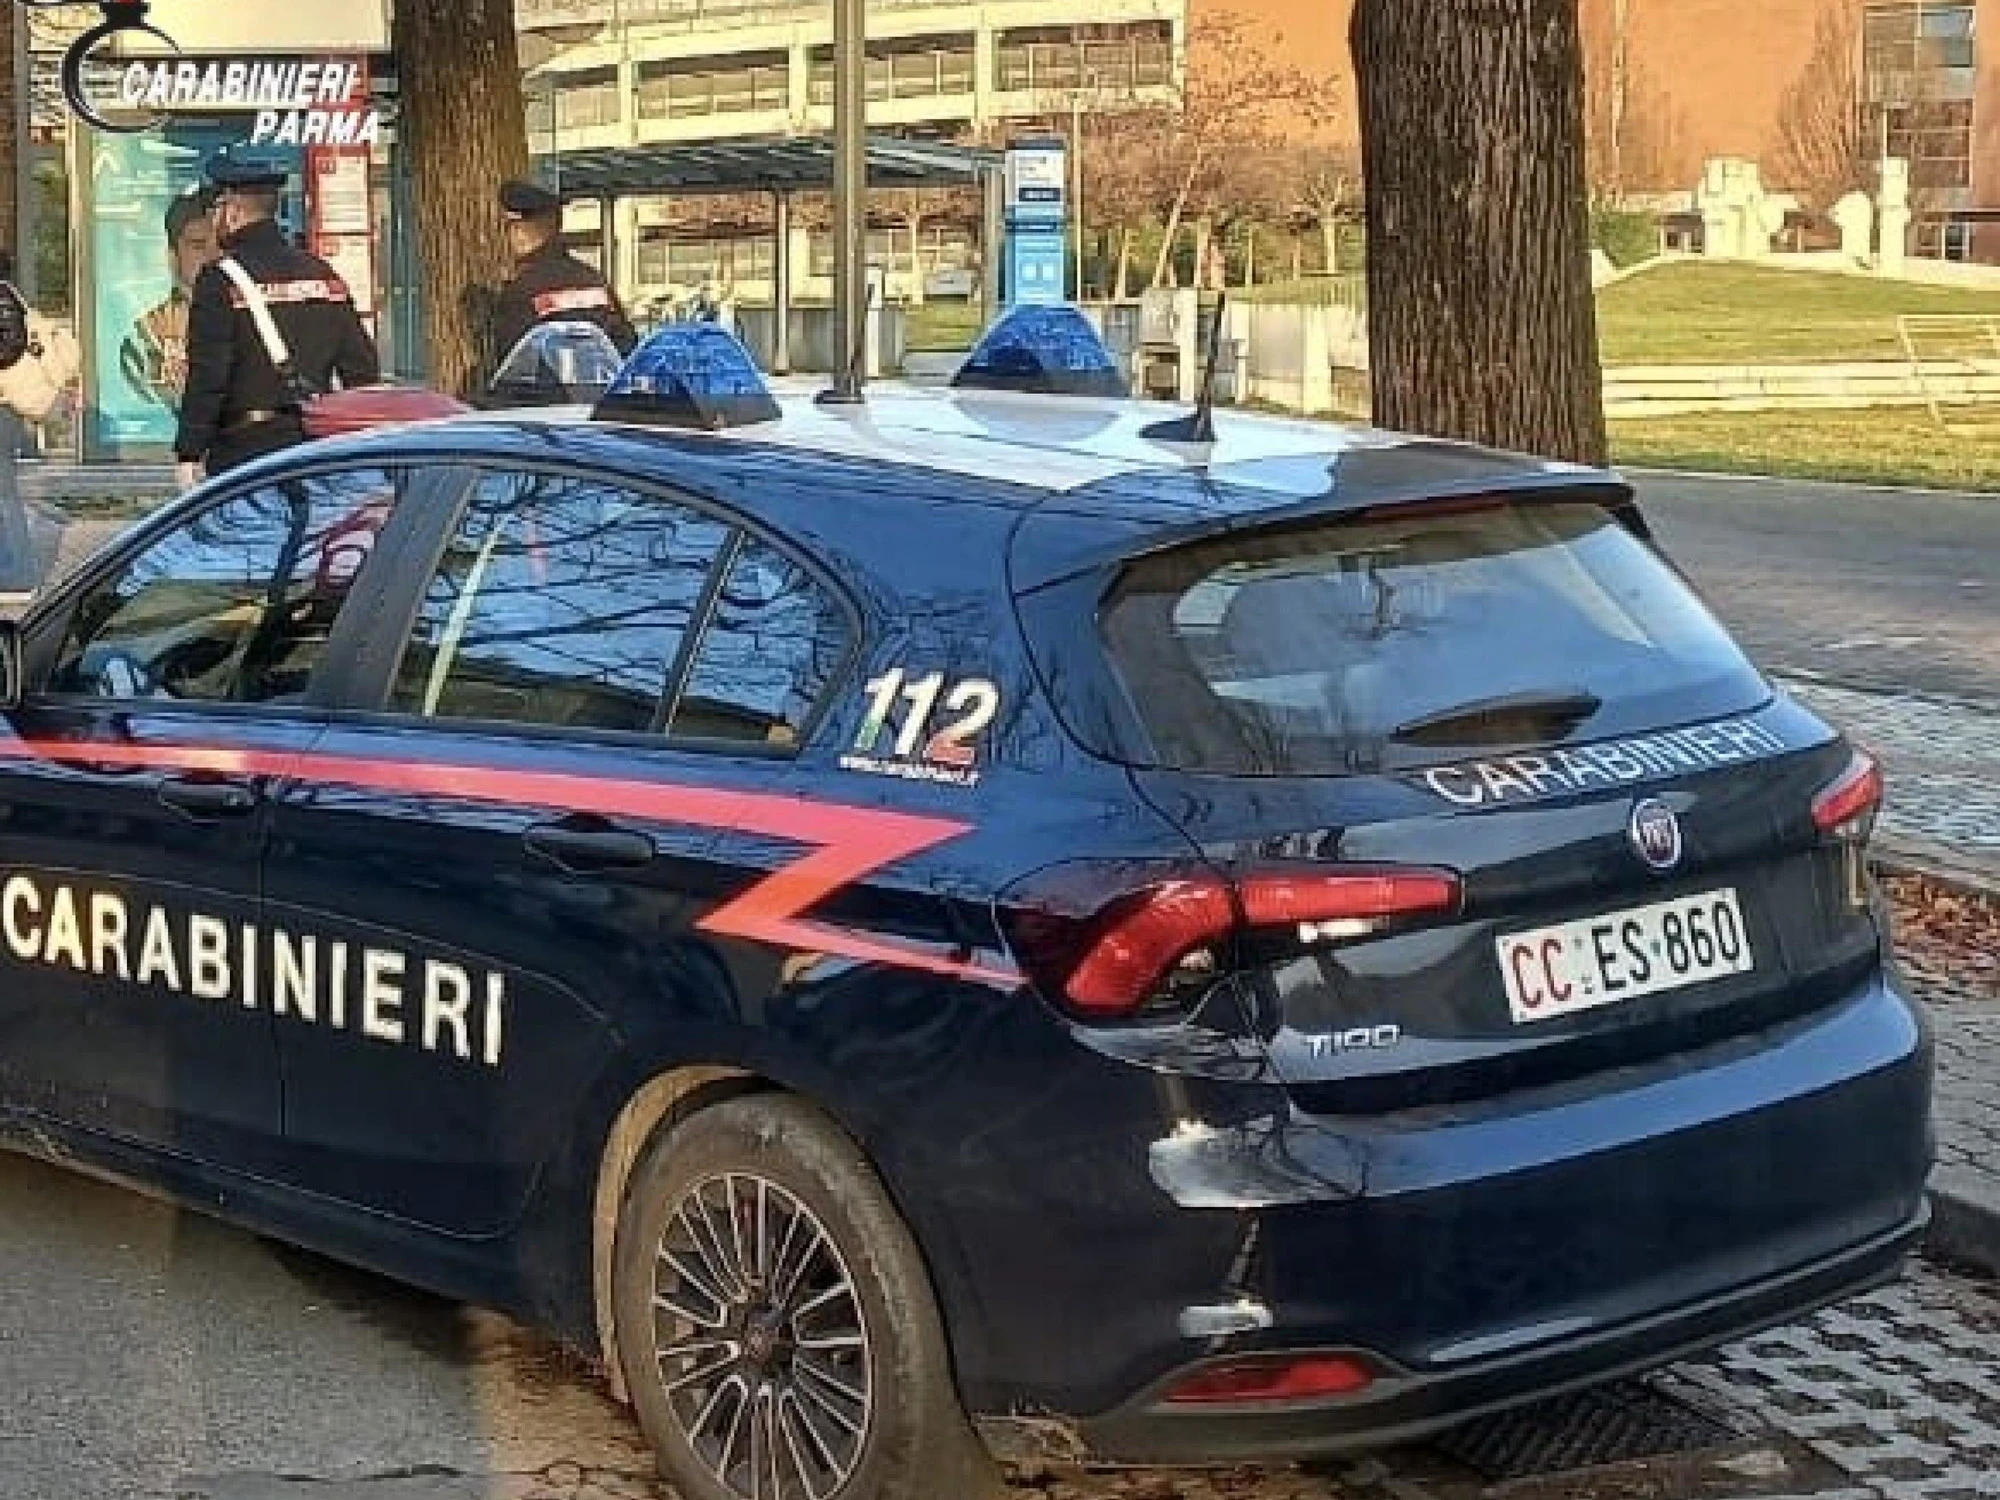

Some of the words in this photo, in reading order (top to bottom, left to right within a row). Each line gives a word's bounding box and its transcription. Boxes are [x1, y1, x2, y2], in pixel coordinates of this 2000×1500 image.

[854, 667, 999, 765] 112
[1425, 719, 1785, 803] CARABINIERI
[2, 875, 504, 1064] CARABINIERI
[1512, 939, 1572, 1009] CC
[1591, 921, 1651, 992] ES
[1663, 901, 1741, 974] 860
